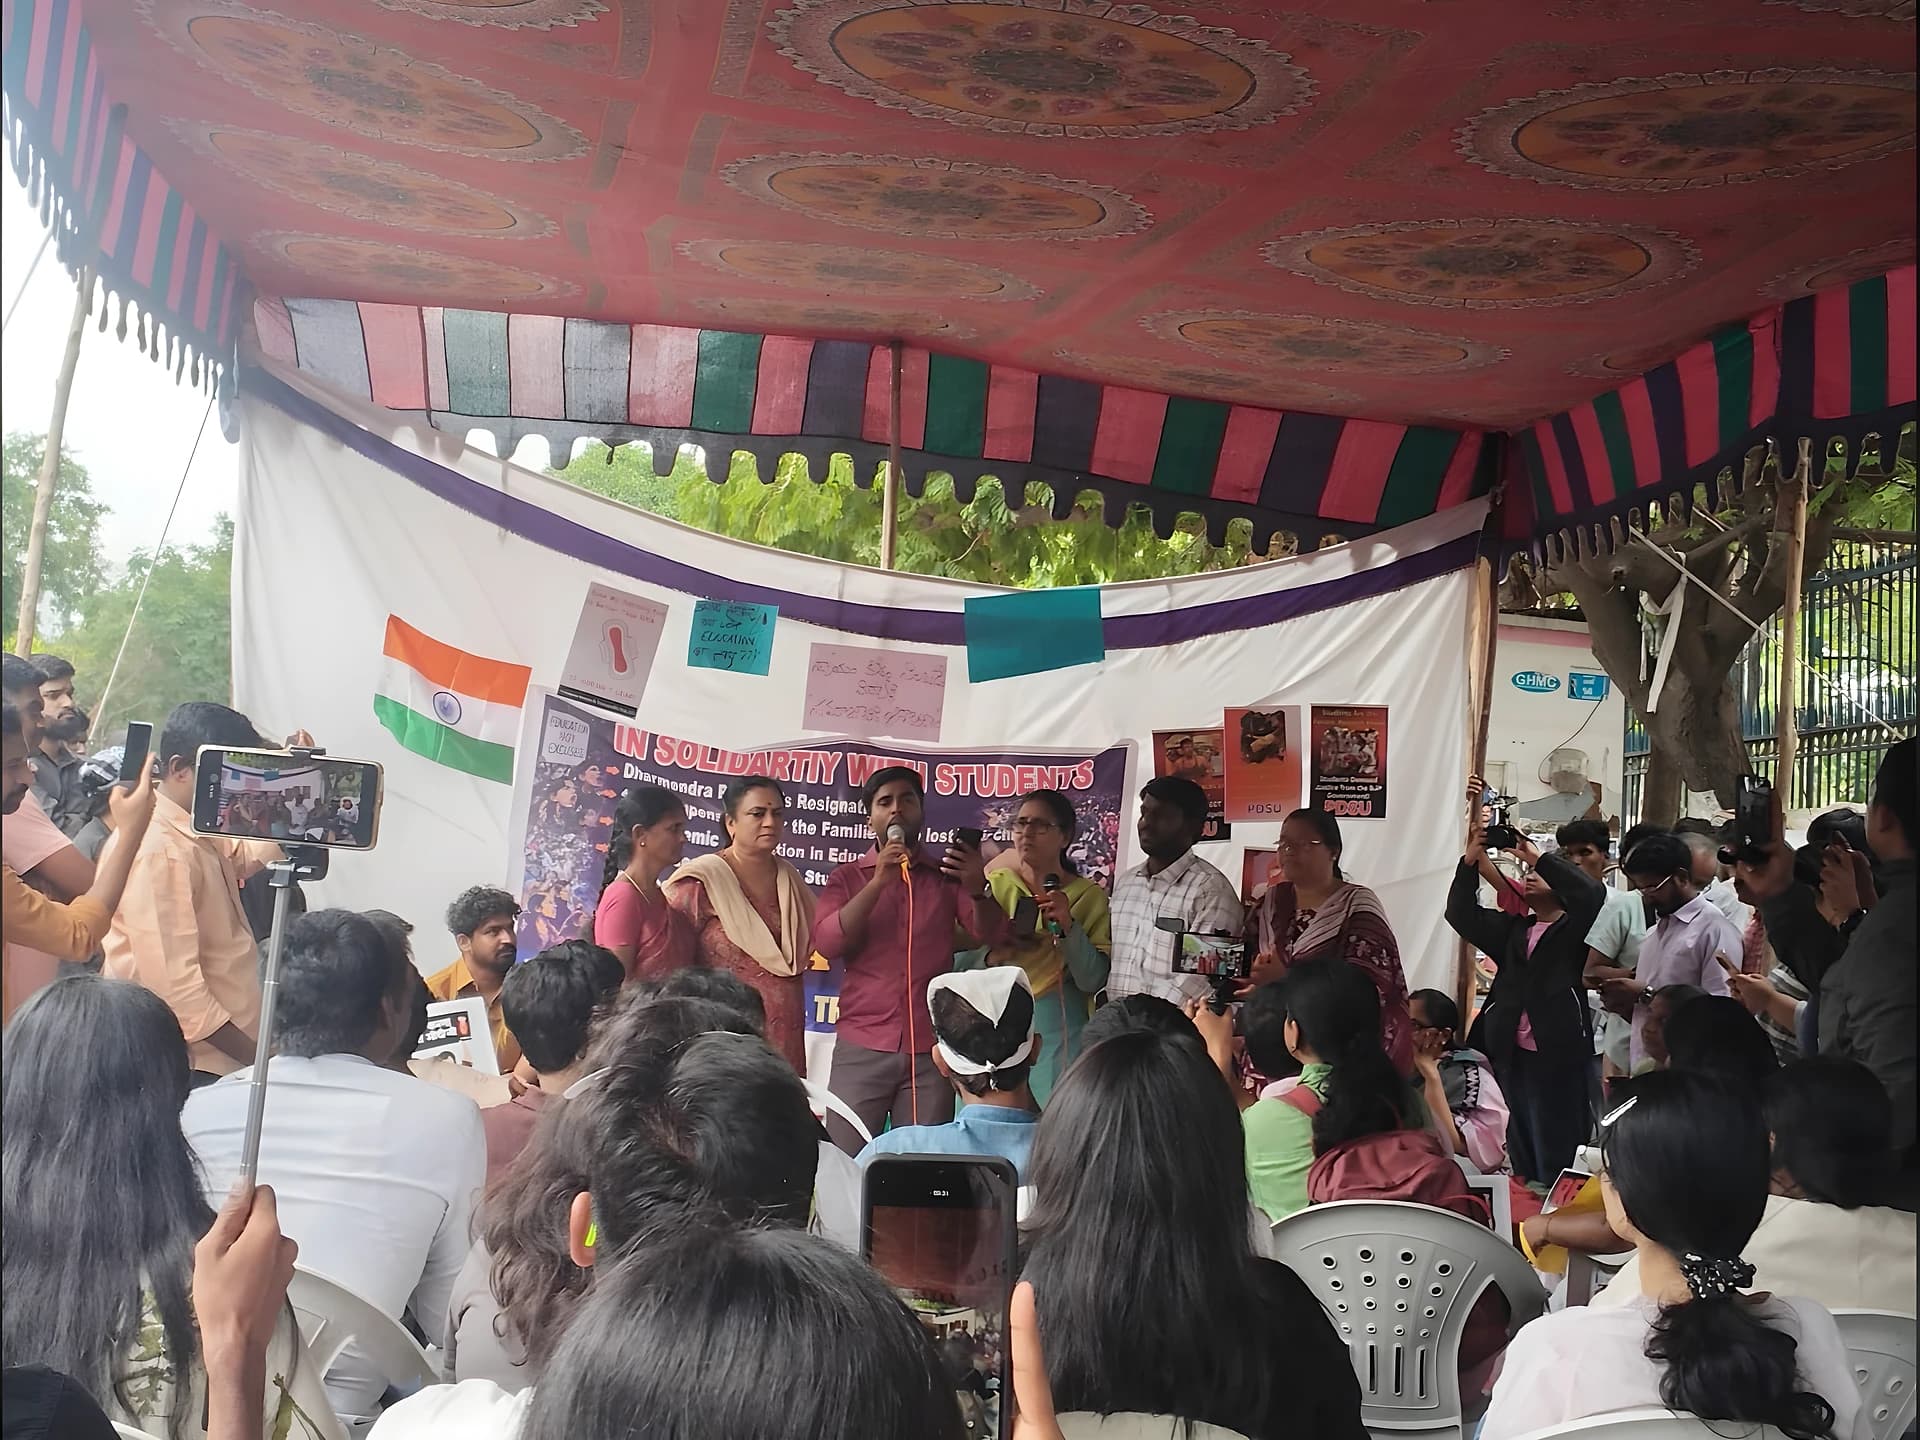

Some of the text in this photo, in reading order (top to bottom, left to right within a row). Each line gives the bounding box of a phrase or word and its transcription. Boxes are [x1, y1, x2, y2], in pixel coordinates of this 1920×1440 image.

[1516, 673, 1557, 688] GHMC
[613, 722, 650, 761] IN
[653, 733, 843, 785] SOLIDARTIY
[935, 759, 1095, 798] STUDENTS
[1247, 803, 1282, 815] PDSU
[821, 821, 877, 840] Familie
